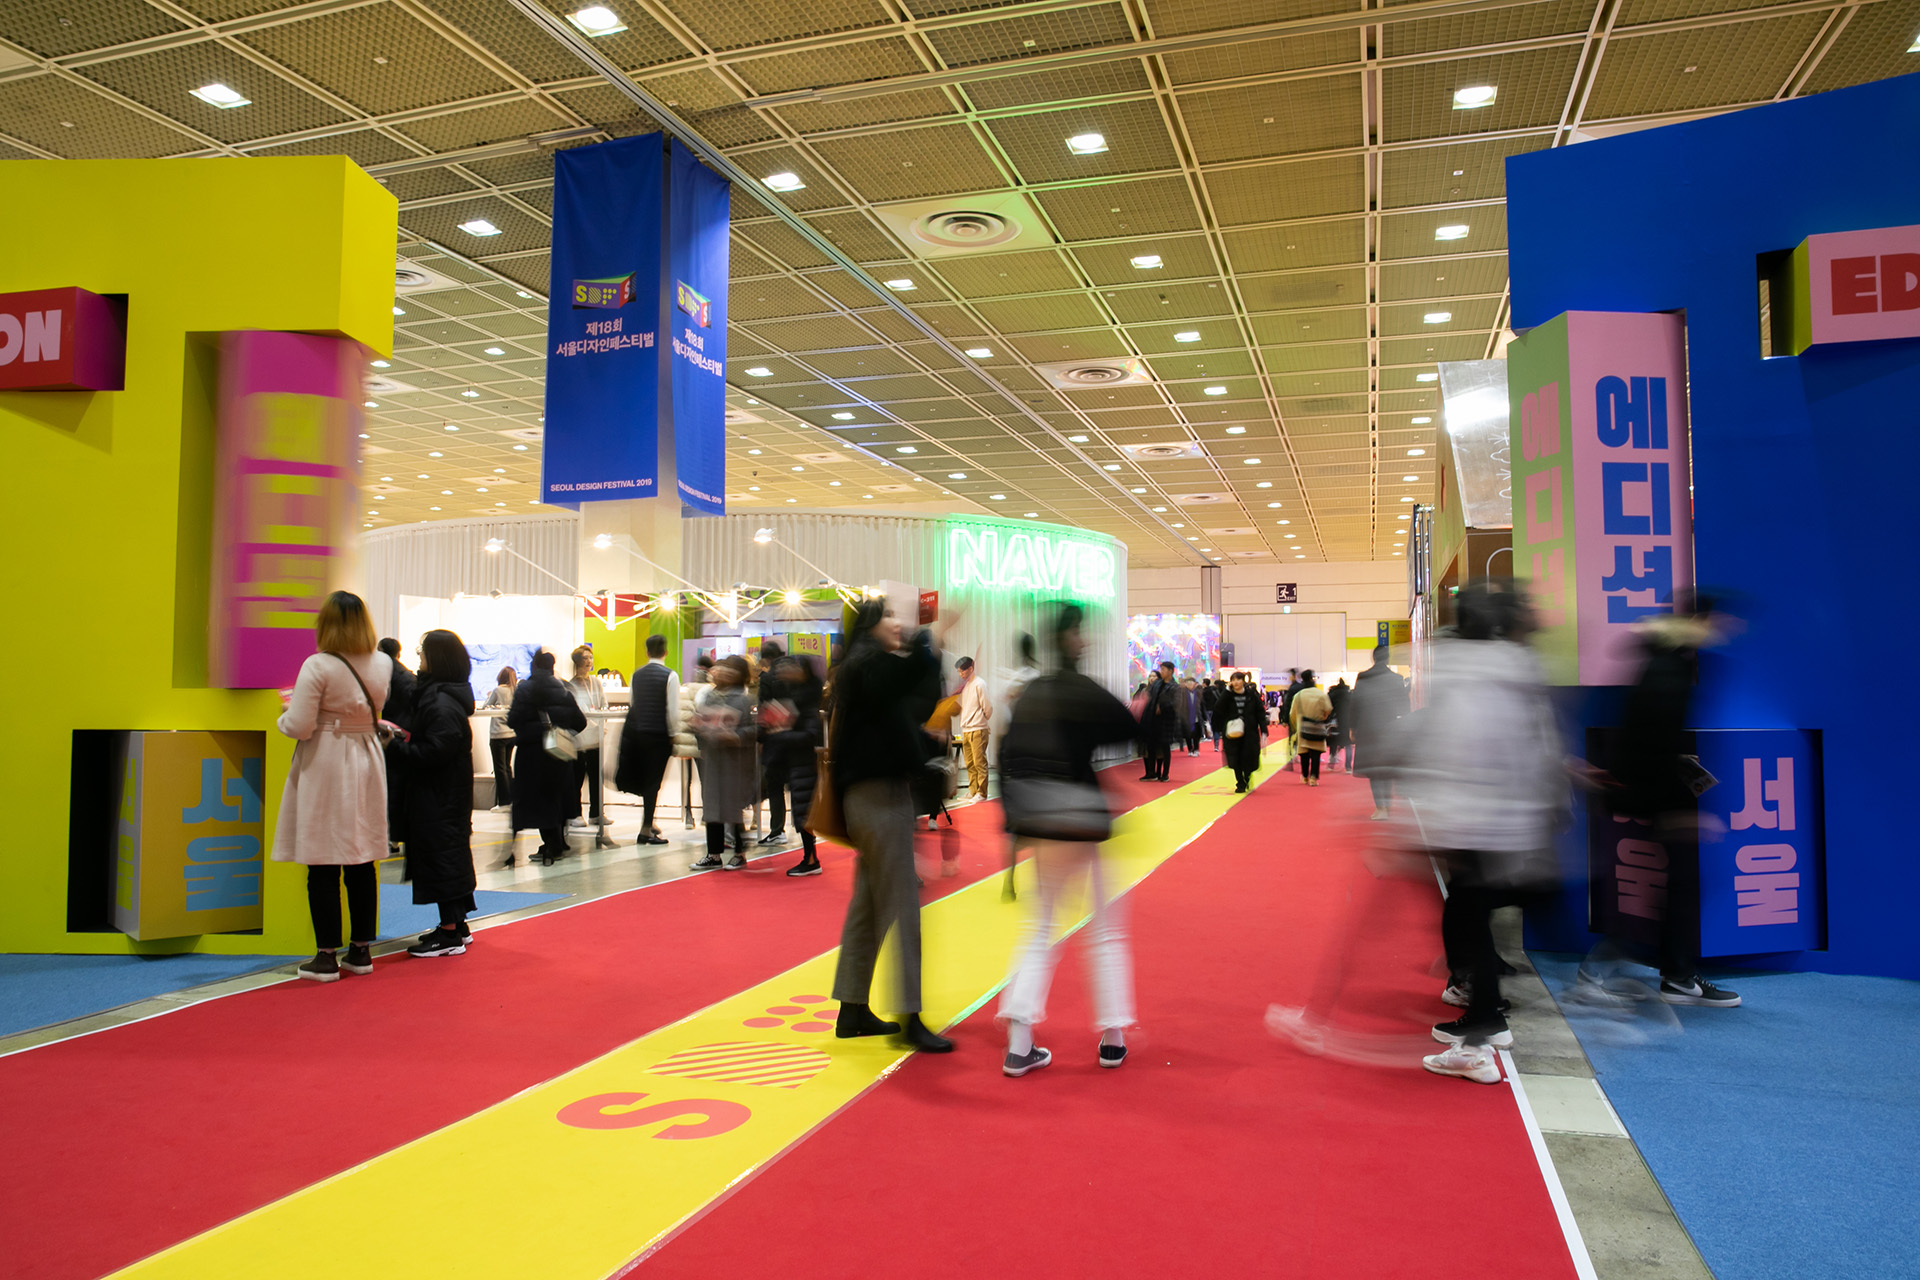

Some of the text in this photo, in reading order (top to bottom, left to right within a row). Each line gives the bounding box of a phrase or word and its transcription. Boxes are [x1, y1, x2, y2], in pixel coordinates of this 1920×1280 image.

[1831, 253, 1920, 315] ED
[556, 332, 655, 357] 서울디자인페스티벌
[585, 317, 623, 336] 제18회
[685, 328, 704, 352] 제18회
[550, 478, 652, 492] SEOUL DESIGN FESTIVAL 2019
[1595, 375, 1674, 624] 에디션
[950, 528, 1115, 597] NAVER
[182, 757, 262, 912] 서울
[1613, 812, 1670, 922] 울
[1730, 757, 1800, 927] 서울
